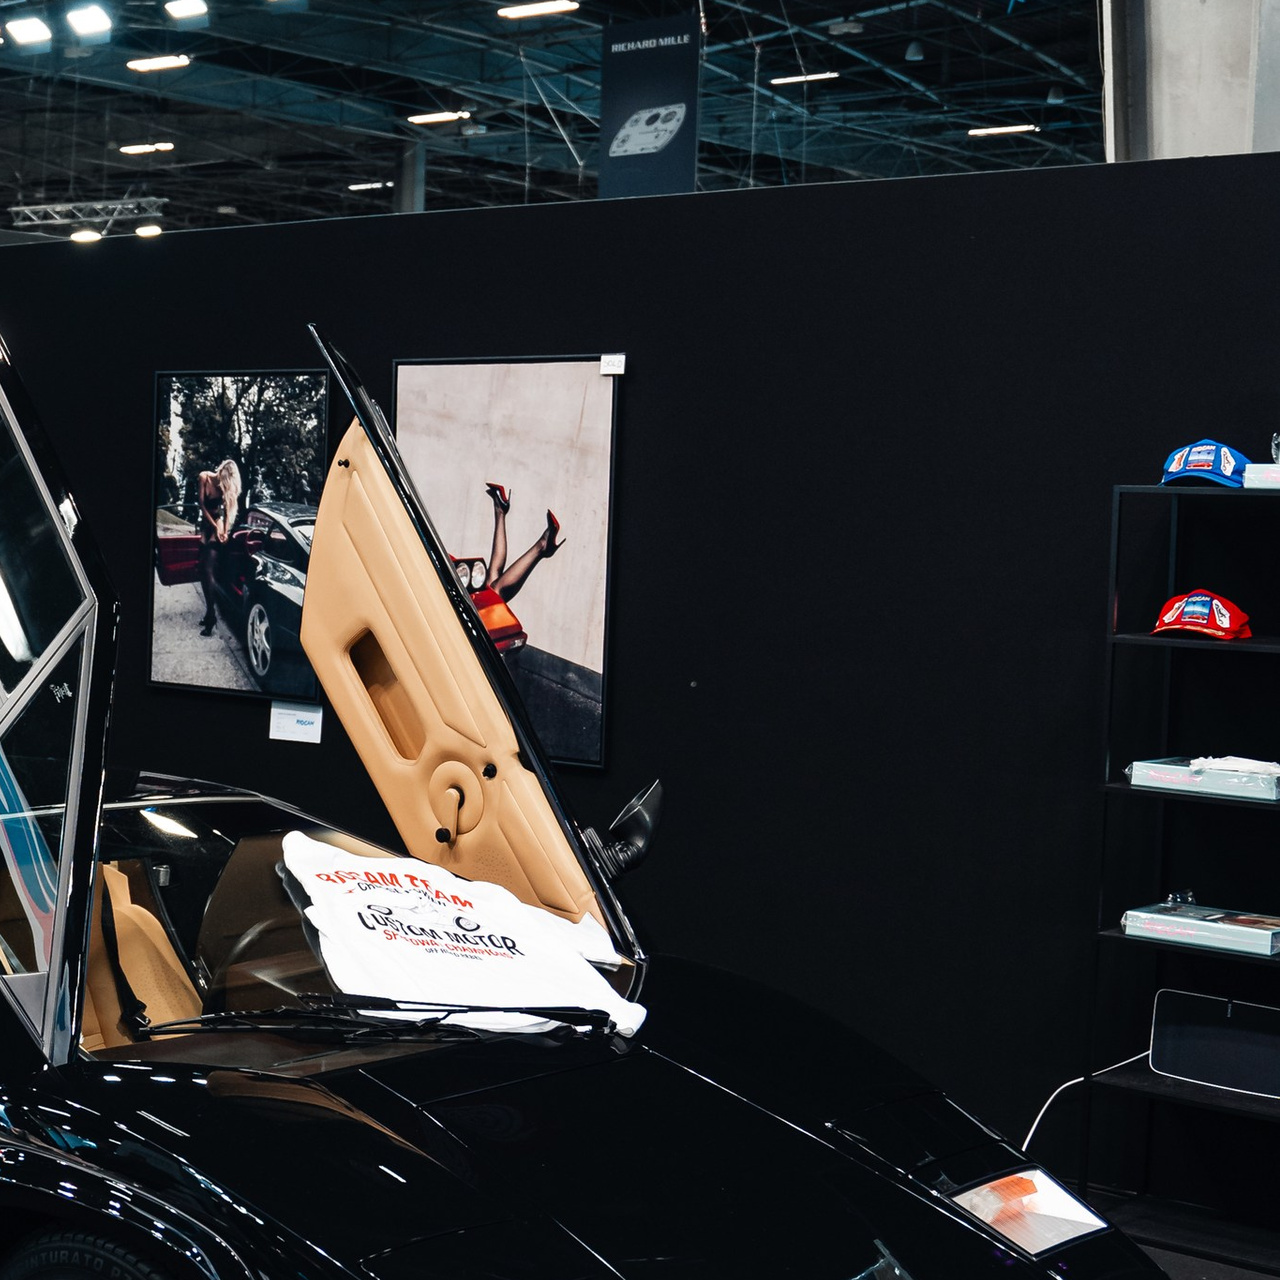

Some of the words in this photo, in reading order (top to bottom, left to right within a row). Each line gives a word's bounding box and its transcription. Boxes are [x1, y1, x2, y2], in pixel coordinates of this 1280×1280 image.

[611, 38, 657, 53] RICHARD
[658, 34, 690, 47] MILLE
[357, 911, 441, 940] CUSTOM
[443, 930, 525, 956] MOTOR
